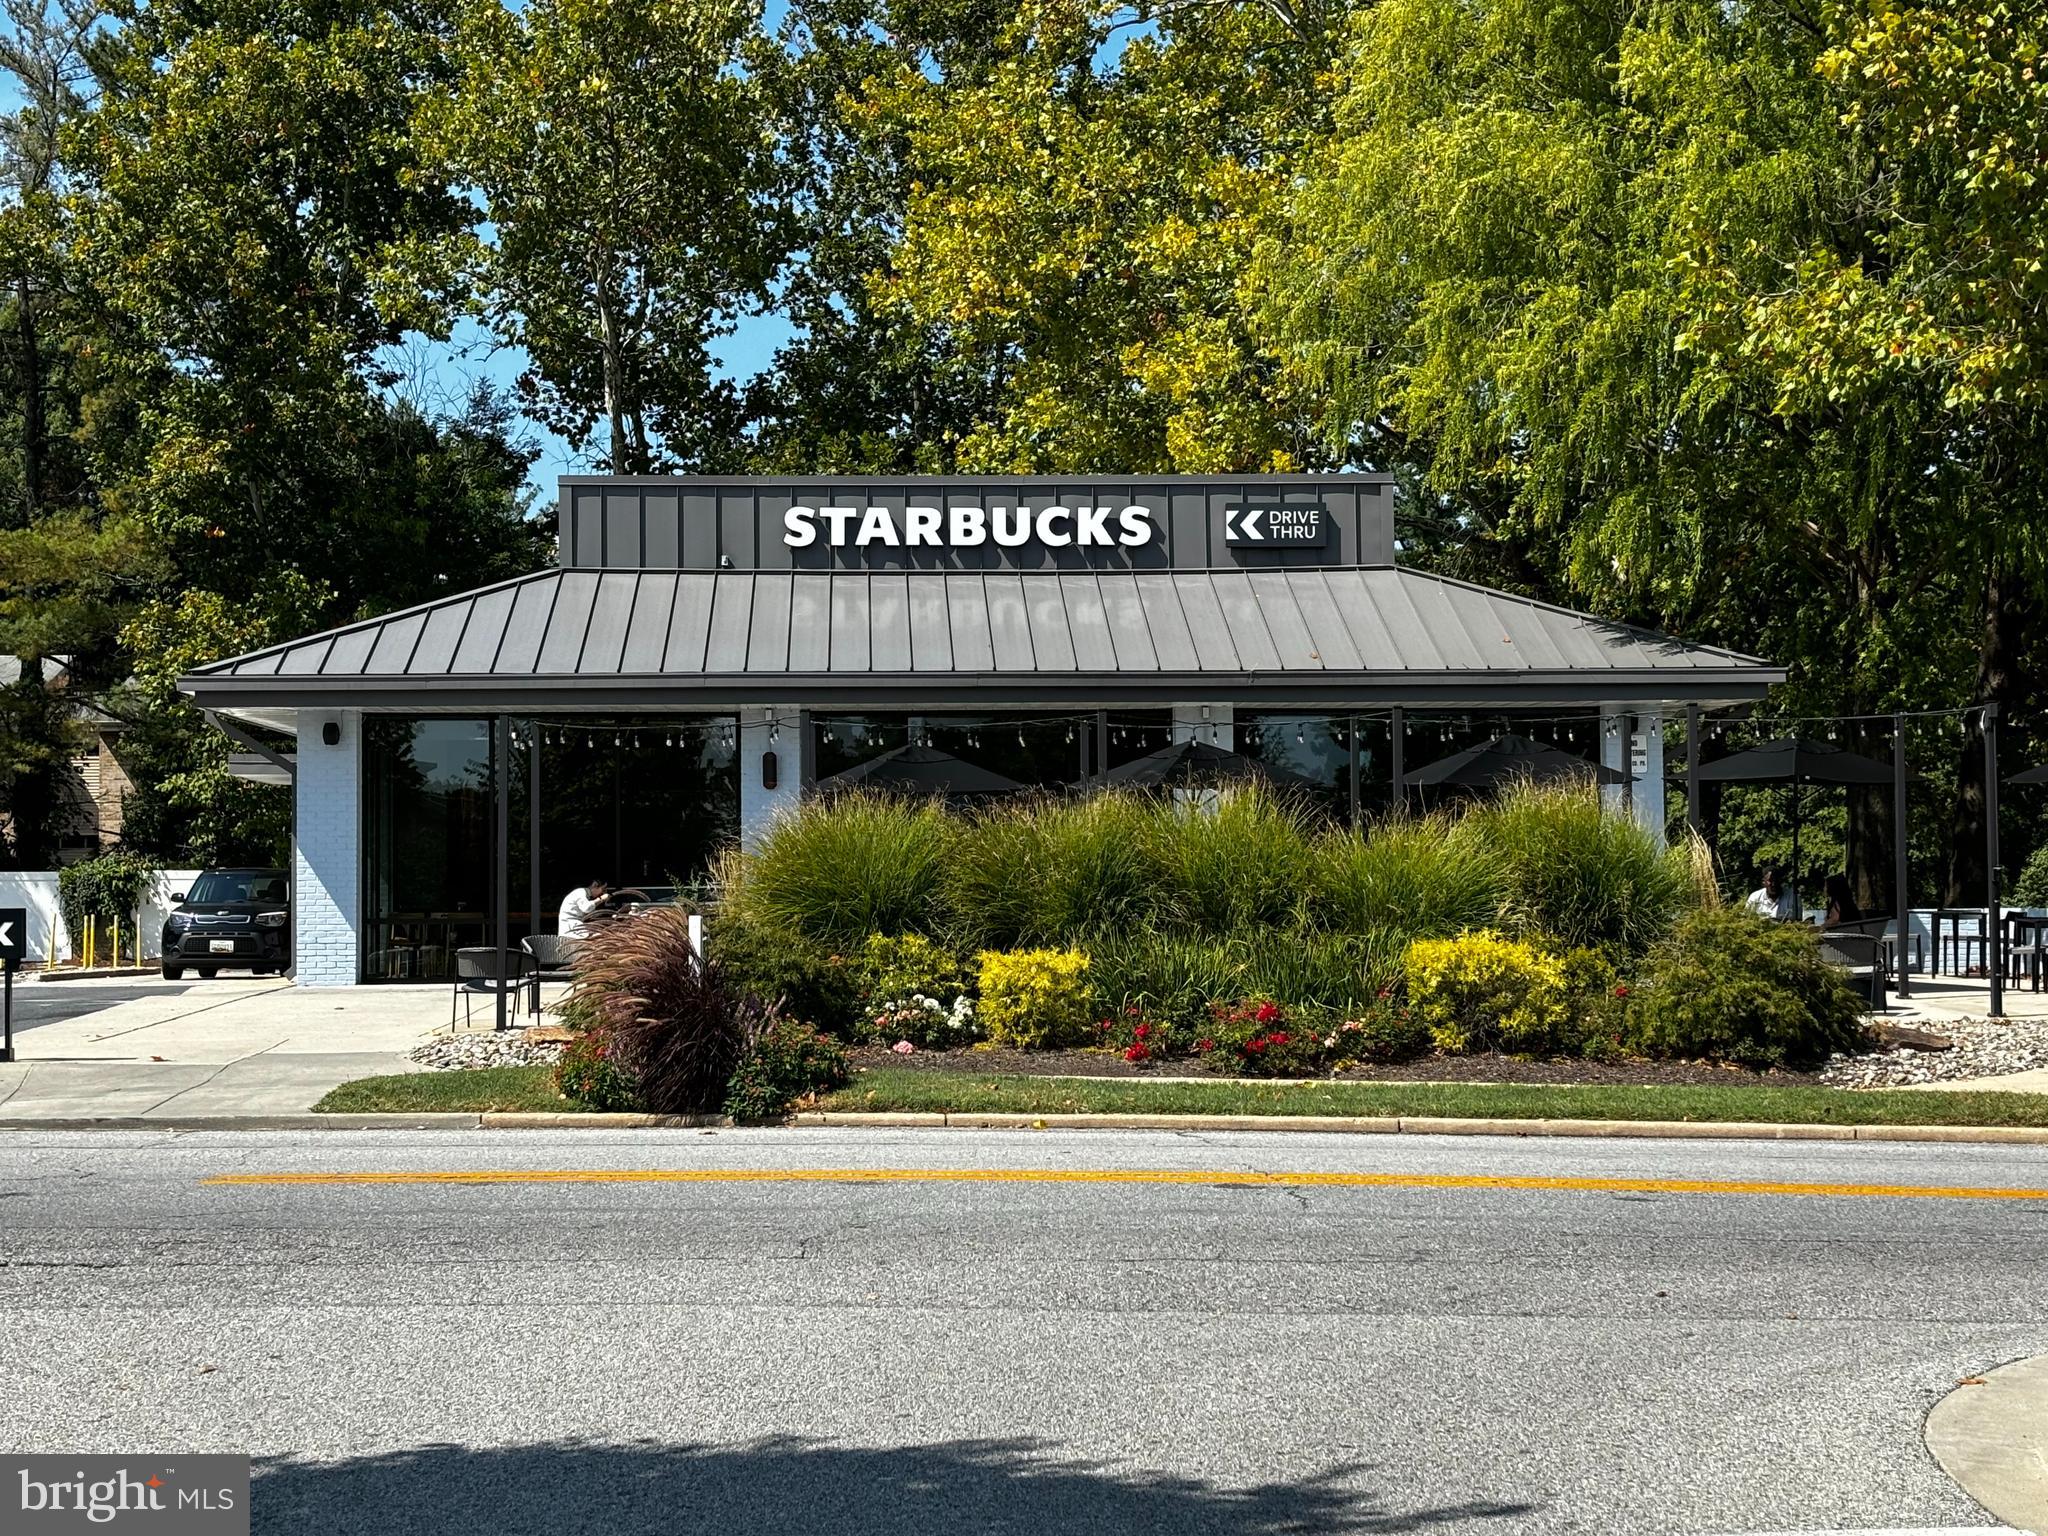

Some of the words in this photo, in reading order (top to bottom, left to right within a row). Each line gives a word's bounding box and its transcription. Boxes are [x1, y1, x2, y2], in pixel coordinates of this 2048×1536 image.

[1269, 510, 1320, 524] DRIVE
[784, 504, 1152, 547] STARBUCKS
[1269, 525, 1316, 539] THRU
